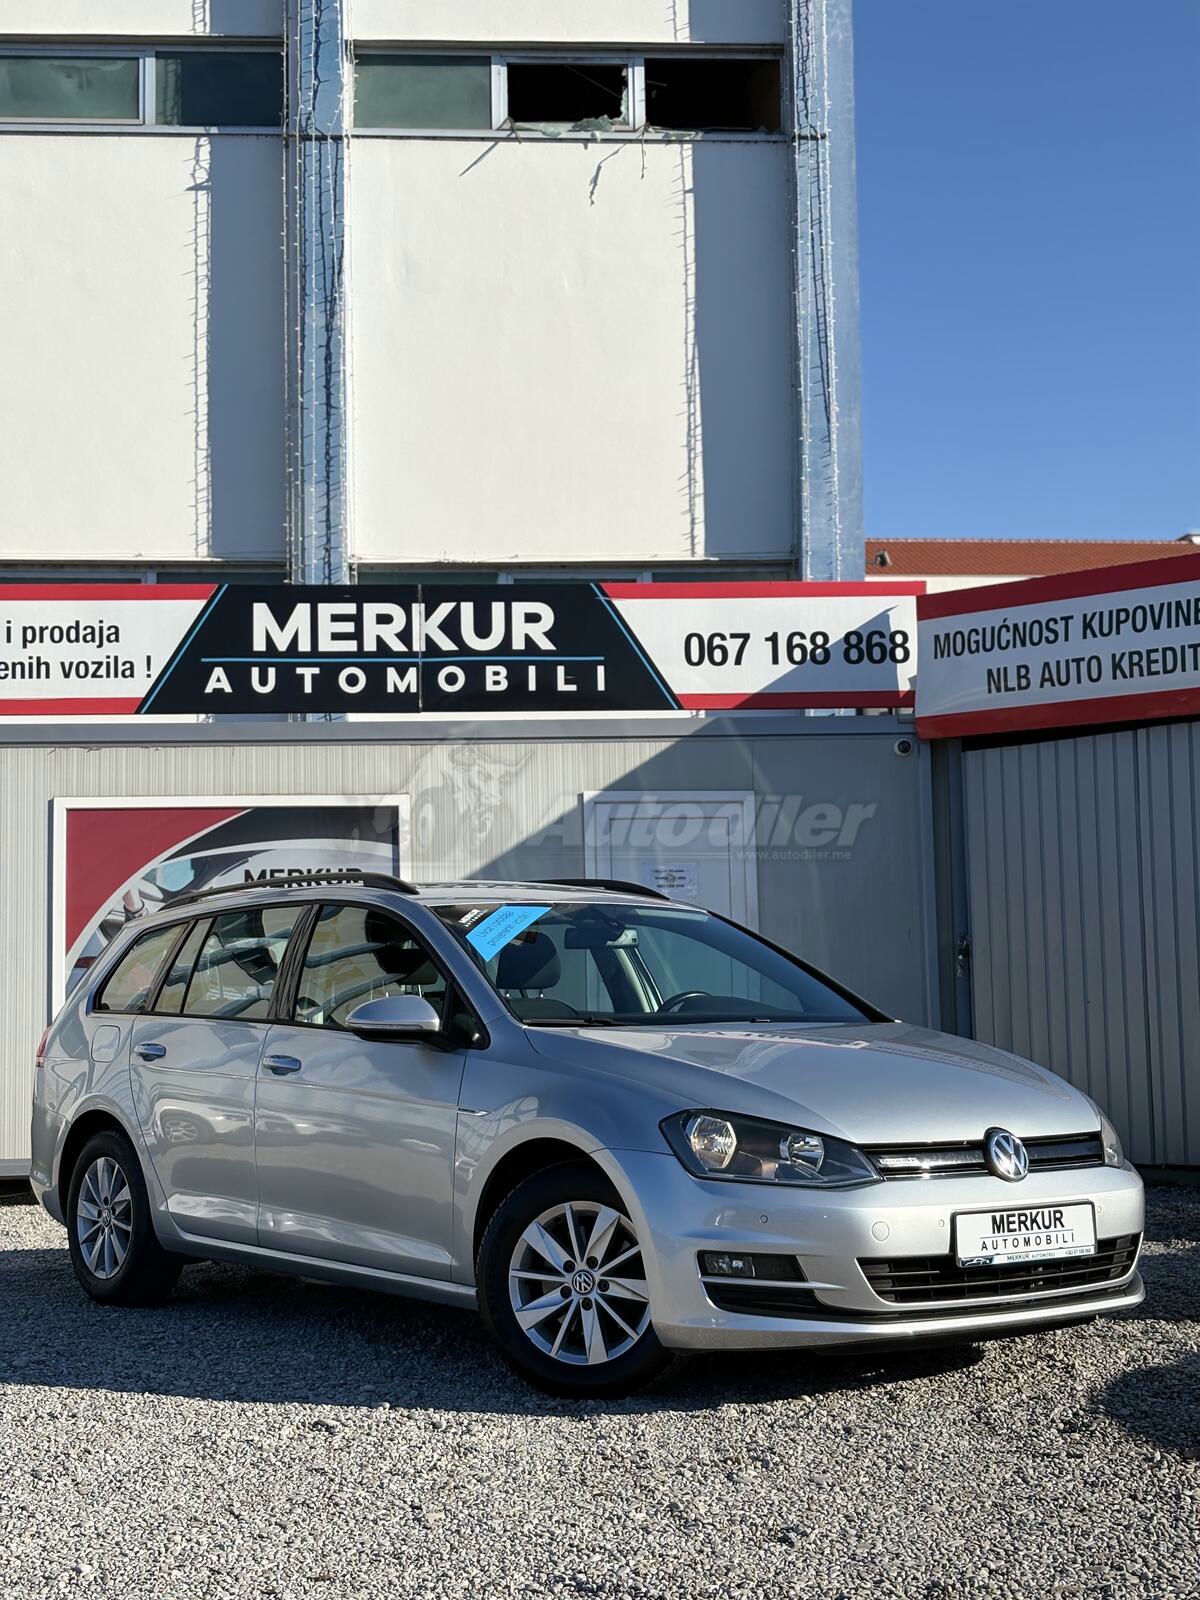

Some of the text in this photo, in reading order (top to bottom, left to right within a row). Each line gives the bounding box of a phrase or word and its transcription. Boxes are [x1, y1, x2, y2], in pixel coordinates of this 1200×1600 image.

[5, 619, 121, 649] i prodaja
[252, 601, 557, 652] MERKUR
[933, 614, 1074, 660] MOGUĆNOST
[683, 629, 911, 667] 067 168 868
[60, 655, 135, 679] vozila
[204, 664, 606, 694] AUTOMOBILI
[986, 642, 1200, 694] NLB AUTO KREDIT
[991, 1209, 1065, 1235] MERKUR
[980, 1231, 1075, 1252] AUTOMOBILI
